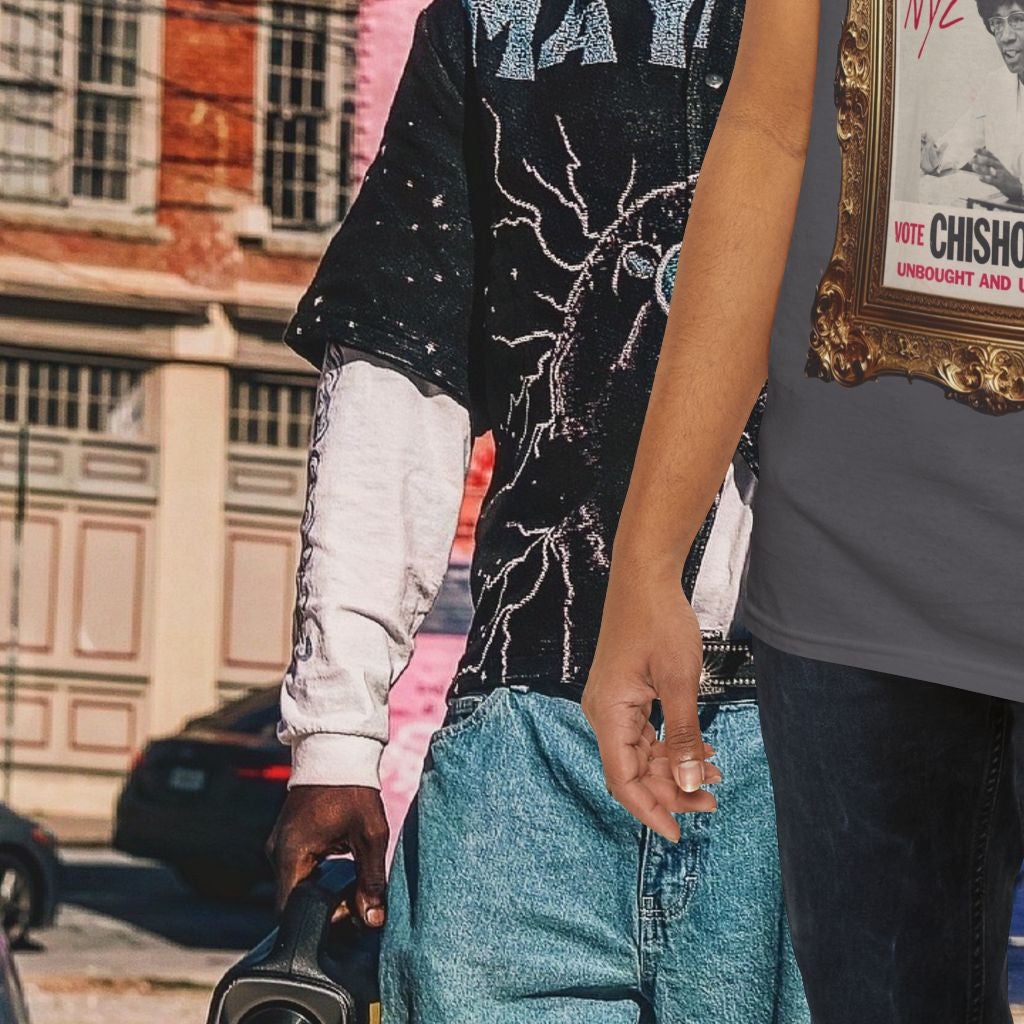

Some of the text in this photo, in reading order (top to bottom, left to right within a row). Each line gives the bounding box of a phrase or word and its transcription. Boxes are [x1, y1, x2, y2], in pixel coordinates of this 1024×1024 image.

[894, 220, 925, 246] VOTE
[896, 261, 976, 288] UNBOUGHT
[978, 273, 1013, 292] AND
